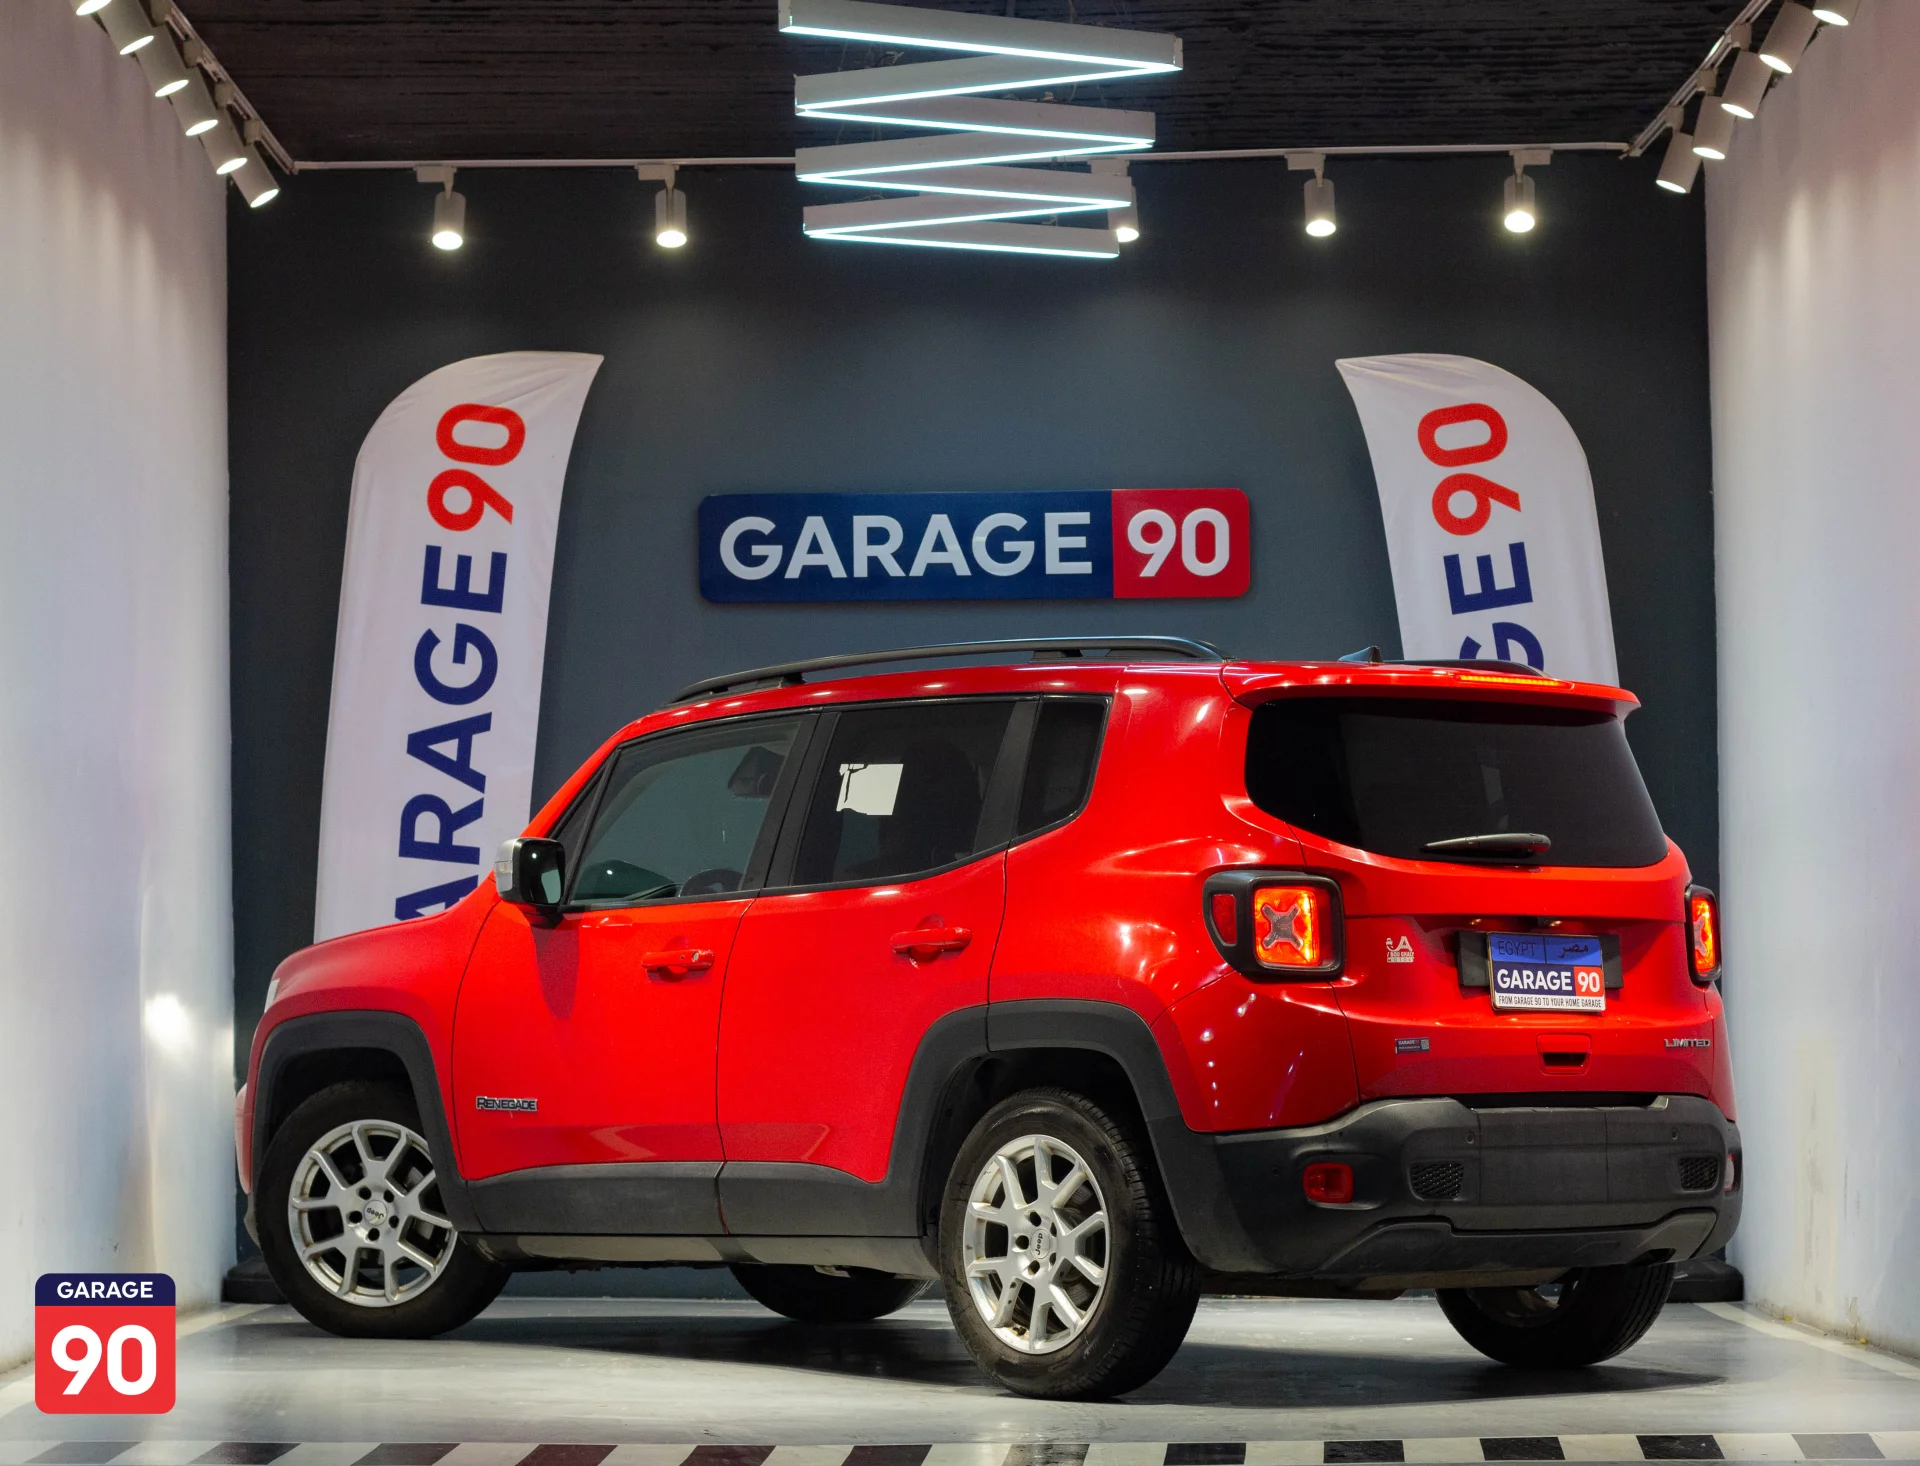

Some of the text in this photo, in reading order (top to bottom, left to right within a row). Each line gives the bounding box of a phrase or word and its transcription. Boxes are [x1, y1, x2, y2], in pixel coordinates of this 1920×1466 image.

[719, 507, 1230, 581] GARAGE 90
[1498, 940, 1536, 956] EGYPT
[1558, 943, 1589, 958] مصر
[1496, 968, 1601, 993] GARAGE 90
[1499, 995, 1602, 1008] FROM GARAGE 90 TO YOUR HOME GARAGE
[1664, 1038, 1711, 1048] LIMITED
[366, 1207, 385, 1219] Jeep
[1035, 1232, 1043, 1255] Jeep
